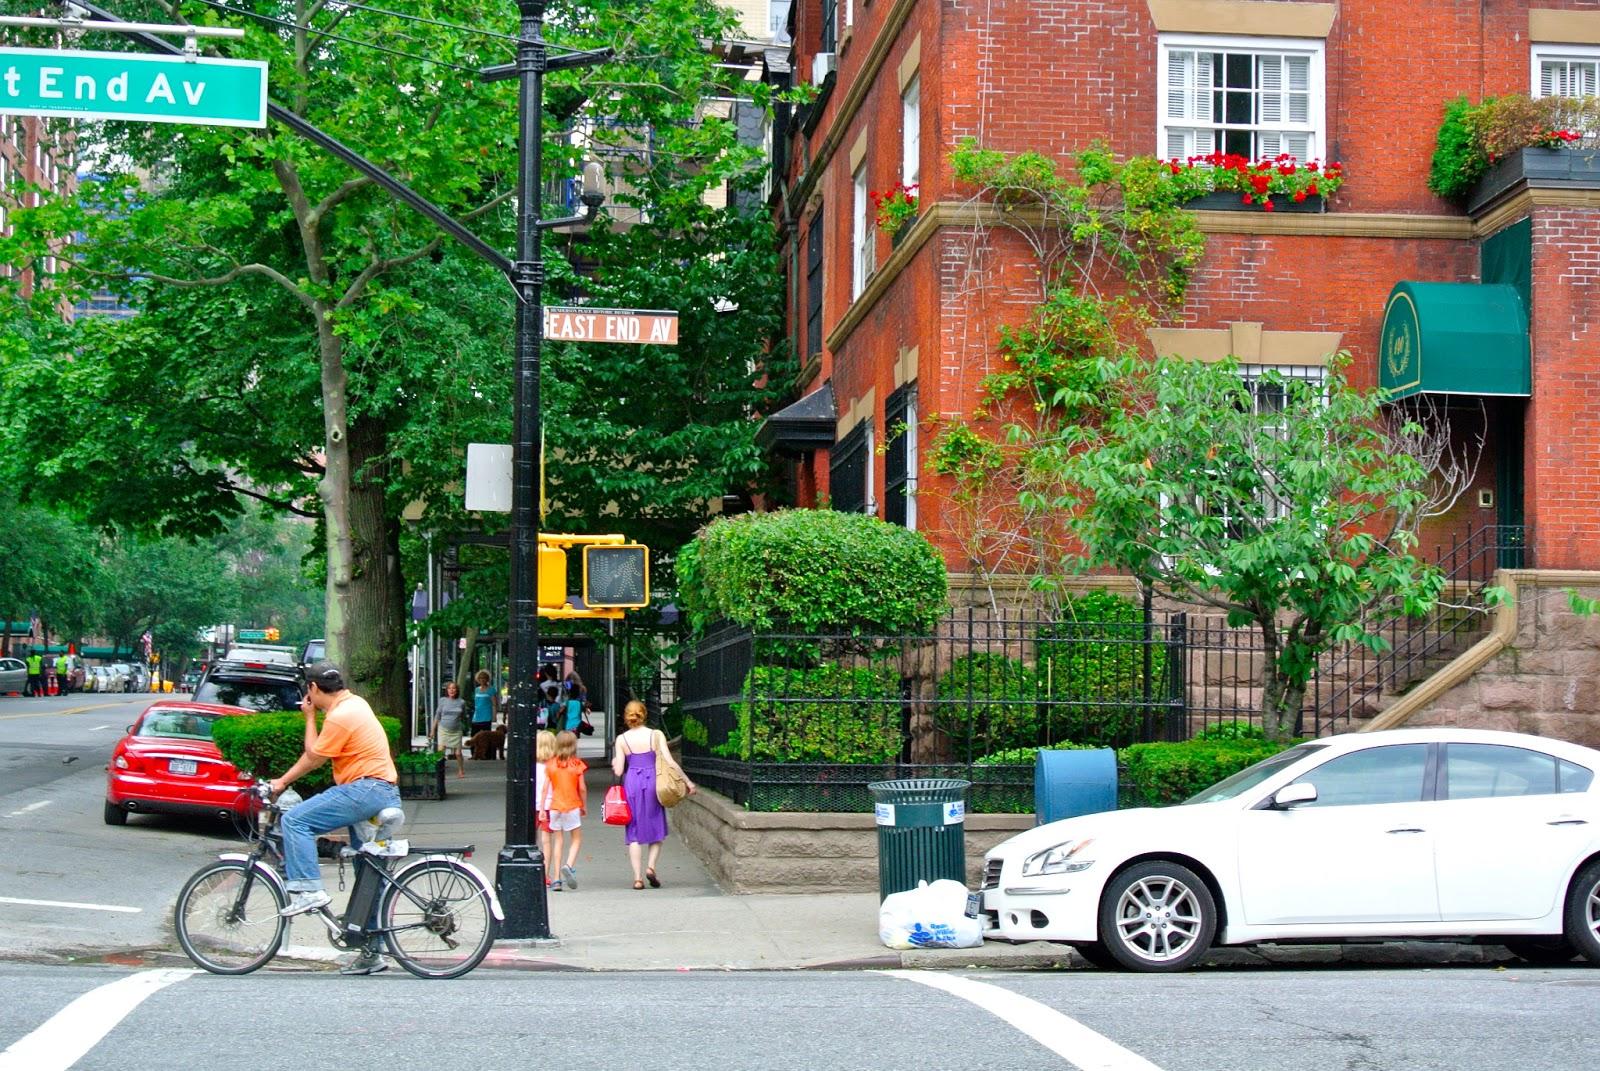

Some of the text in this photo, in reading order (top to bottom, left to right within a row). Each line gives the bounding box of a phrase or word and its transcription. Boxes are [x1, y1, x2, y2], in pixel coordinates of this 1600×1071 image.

[39, 66, 128, 102] End
[145, 72, 206, 106] Av
[550, 315, 672, 342] EAST END AV
